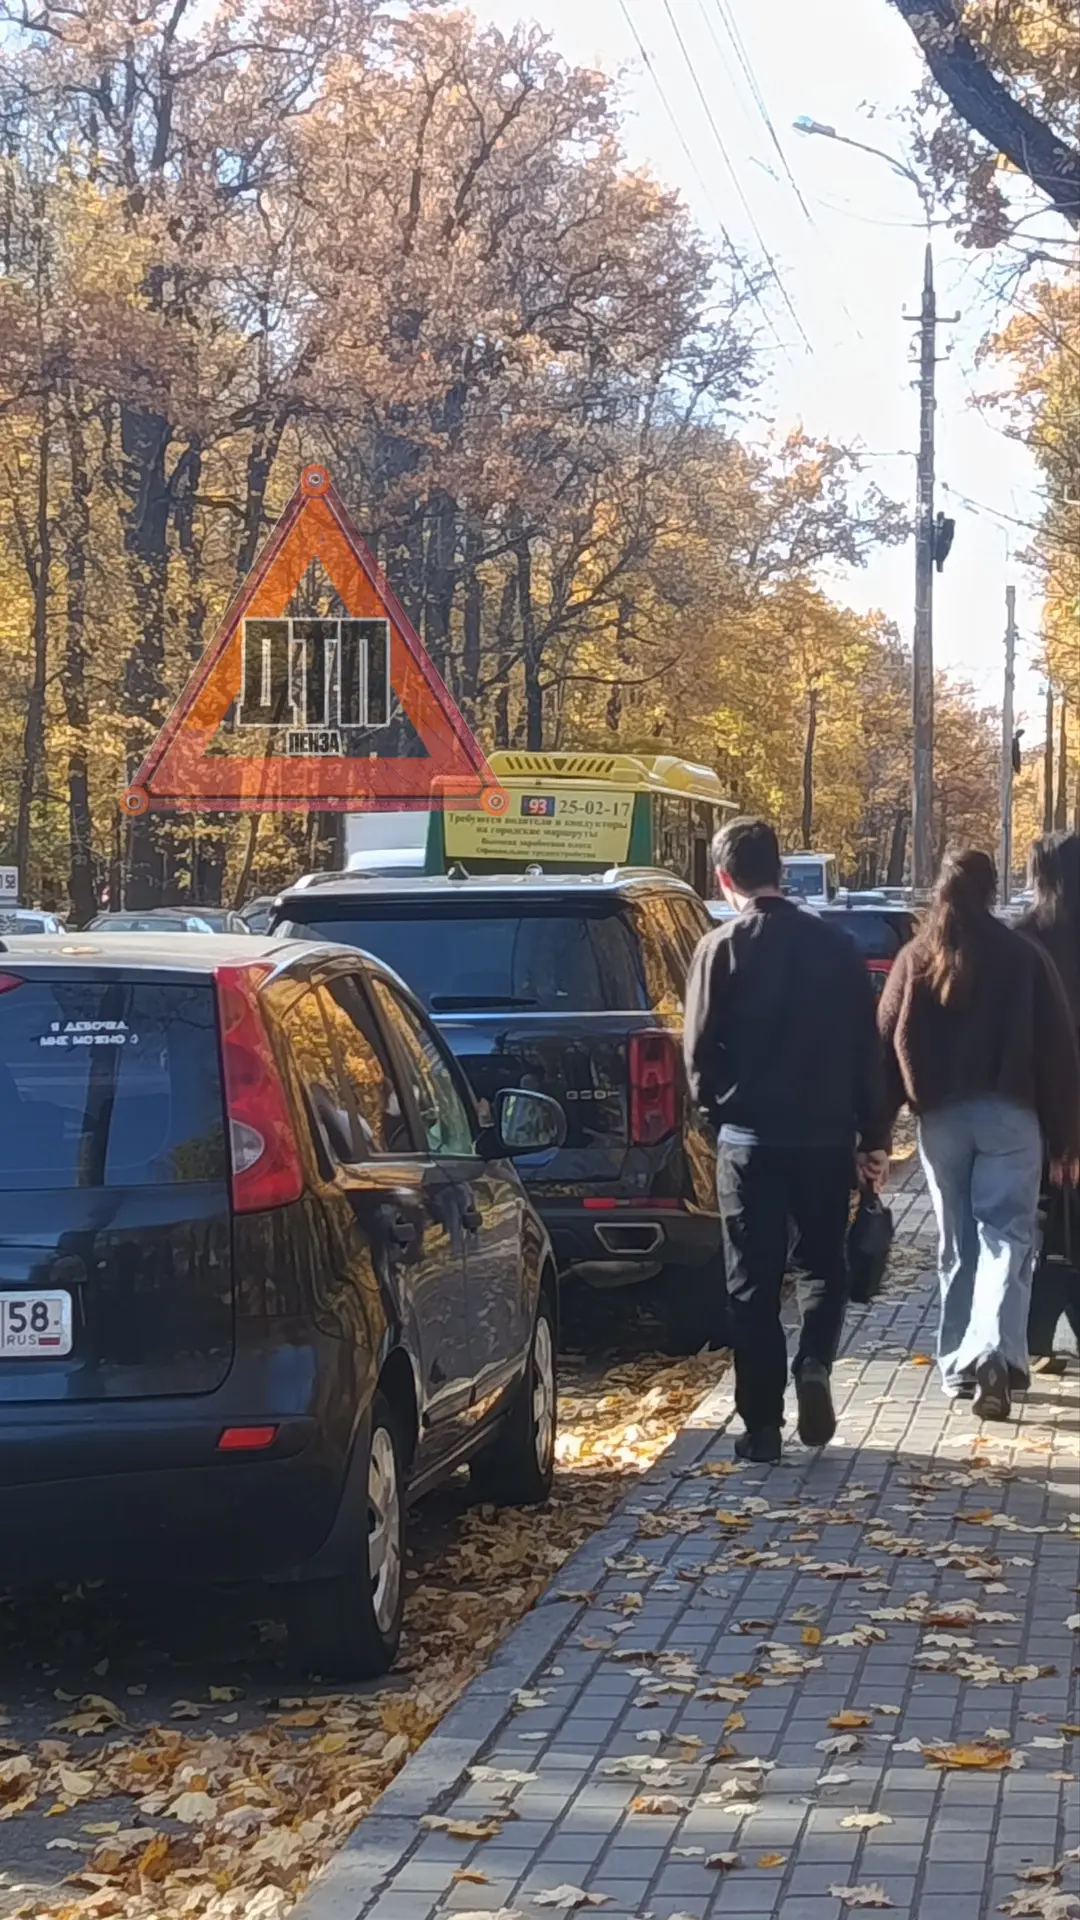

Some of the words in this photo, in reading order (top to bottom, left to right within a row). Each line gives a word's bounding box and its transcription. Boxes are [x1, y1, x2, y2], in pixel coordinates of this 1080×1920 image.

[529, 799, 548, 814] 93
[559, 800, 631, 817] 25-02-17
[9, 1301, 49, 1333] 58
[7, 1334, 37, 1346] RUS
